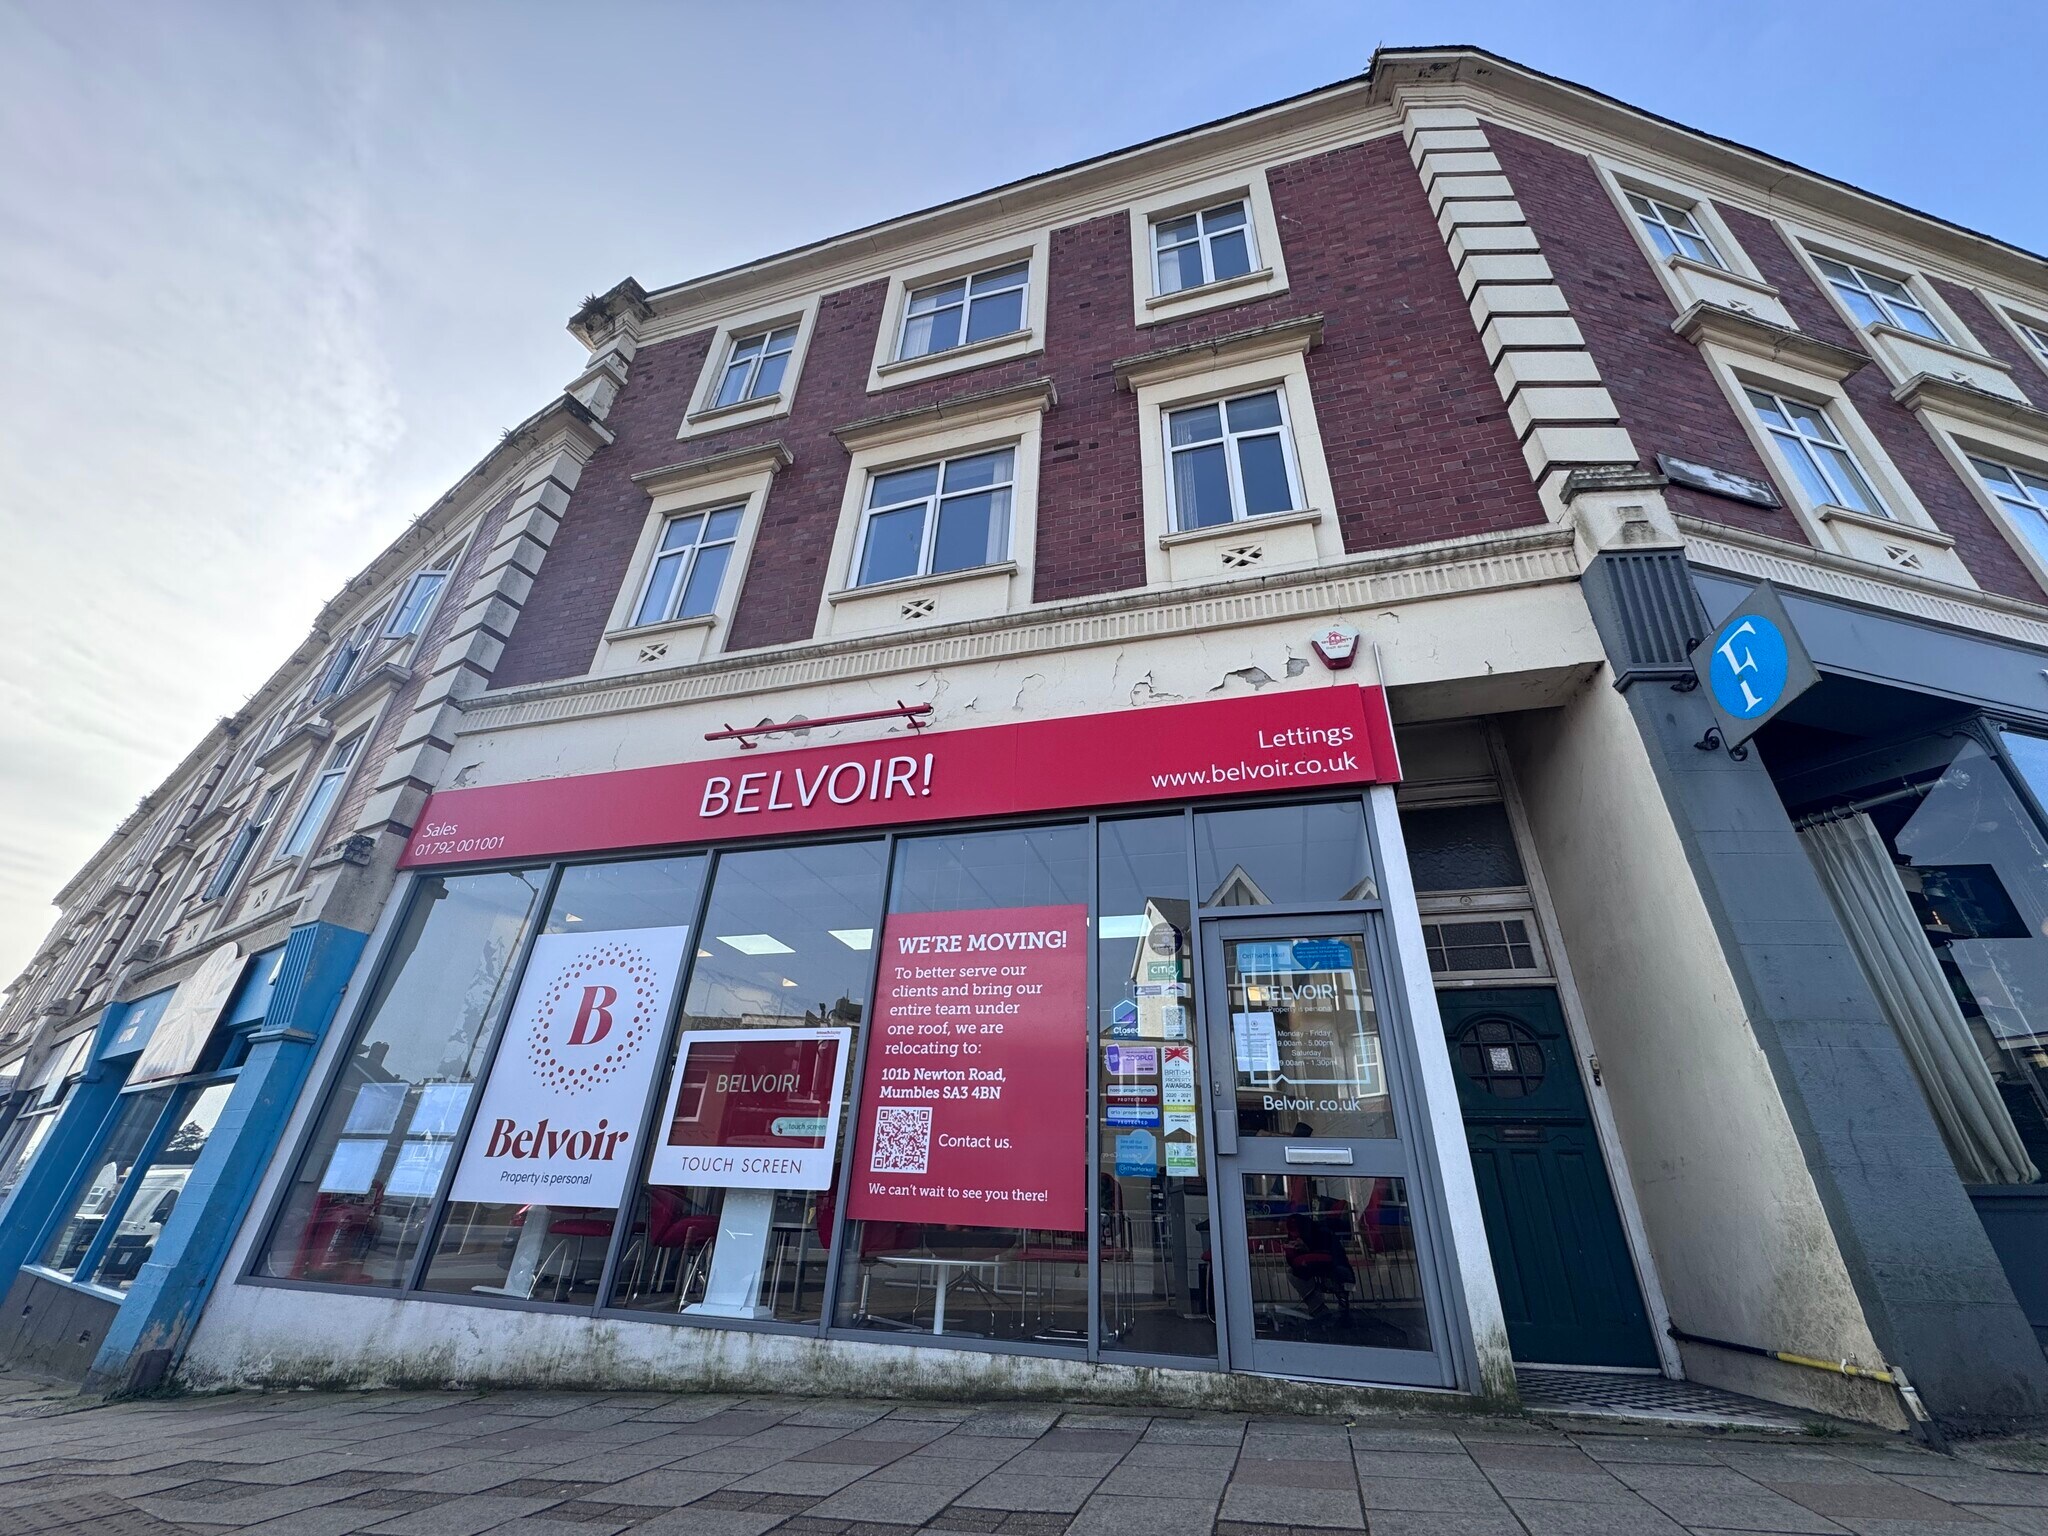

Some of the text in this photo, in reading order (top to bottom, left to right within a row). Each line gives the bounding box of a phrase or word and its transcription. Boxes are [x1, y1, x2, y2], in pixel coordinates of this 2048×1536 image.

[1258, 726, 1353, 749] Lettings
[1152, 751, 1358, 788] www.belvoir.co.uk
[699, 753, 934, 817] BELVOIR!
[423, 822, 458, 837] Sales
[415, 836, 504, 856] 01792 001001
[898, 931, 1067, 955] WE'RE MOVING!
[895, 965, 1027, 979] To better serve our
[892, 983, 1043, 998] clients and bring our
[566, 985, 617, 1045] B
[890, 1002, 1020, 1016] entire team under
[888, 1021, 1004, 1036] one roof, we are
[885, 1041, 982, 1057] relocating to:
[881, 1068, 1006, 1082] 101b Newton Road,
[716, 1074, 800, 1093] BELVOIR!
[880, 1086, 1001, 1099] Mumbles SA3 4BN
[1263, 1096, 1361, 1111] Belvoir.co.uk
[484, 1118, 628, 1160] Belvoir
[938, 1134, 1013, 1149] Contact us.
[682, 1157, 802, 1174] TOUCH SCREEN
[500, 1171, 592, 1186] Property is personal
[868, 1183, 1048, 1202] We can't wait to see you there!
